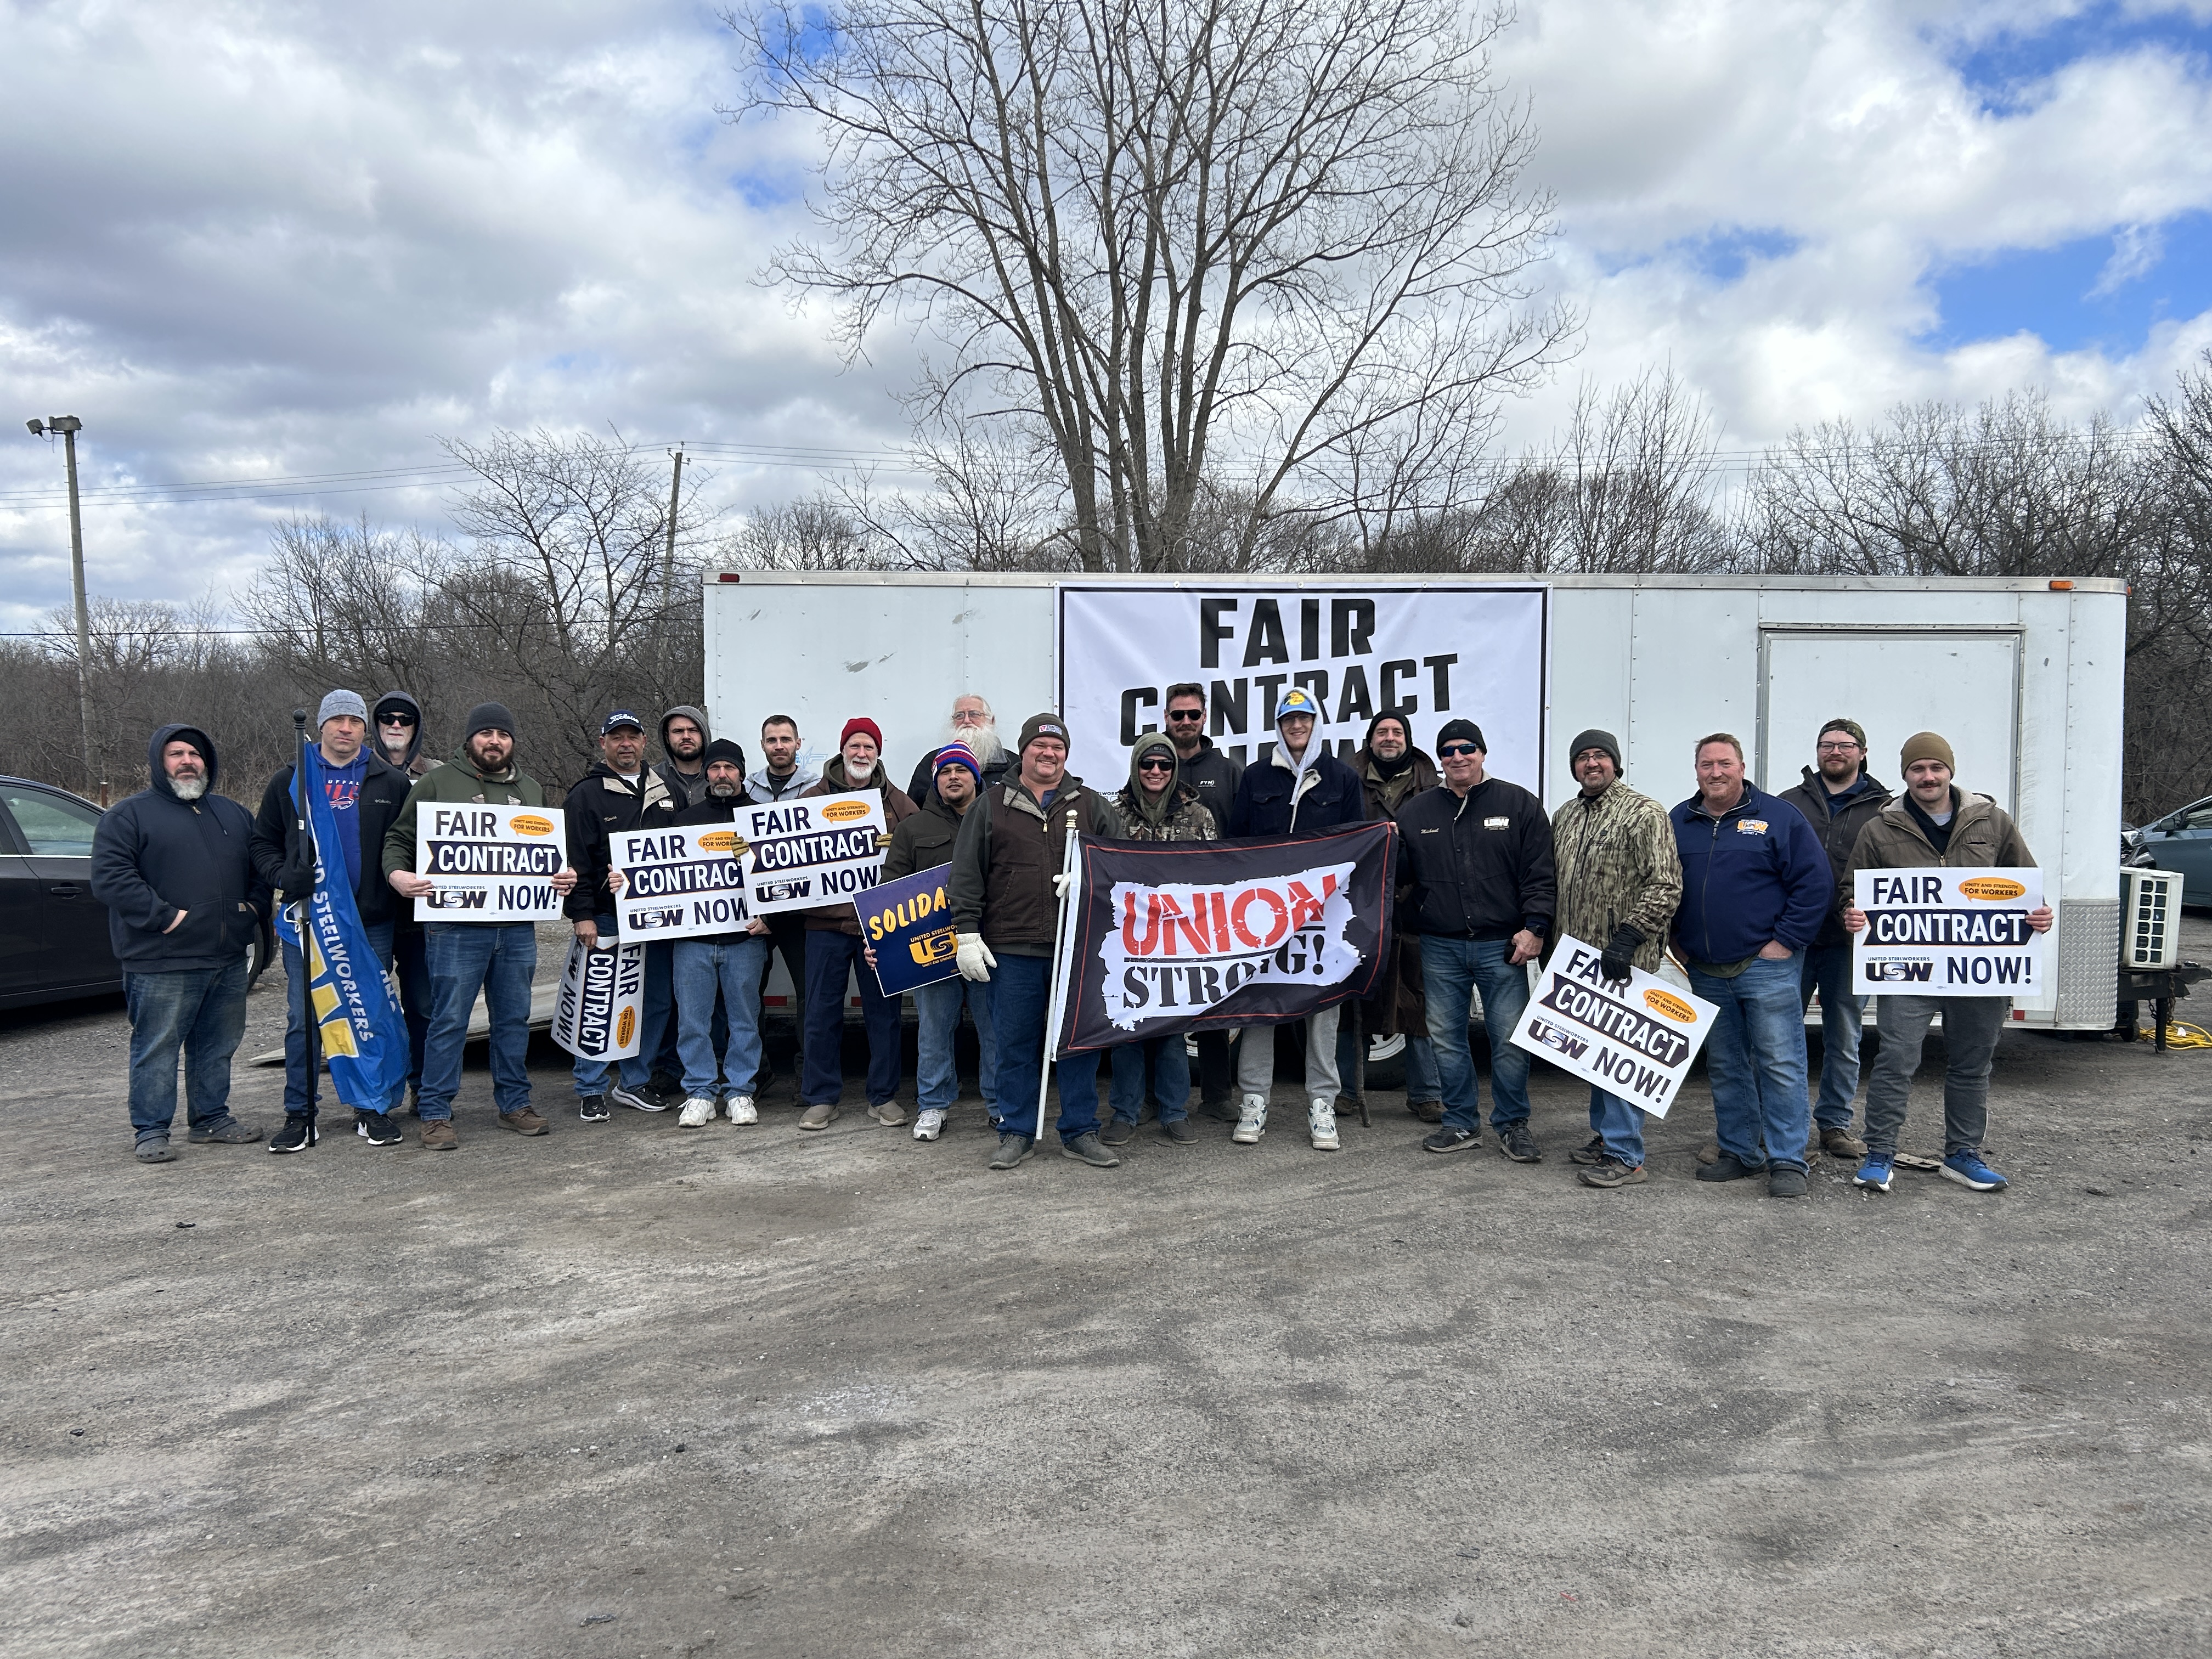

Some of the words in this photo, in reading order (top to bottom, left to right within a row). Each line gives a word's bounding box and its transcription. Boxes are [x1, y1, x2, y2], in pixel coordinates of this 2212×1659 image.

[1200, 599, 1375, 668] FAIR
[1120, 653, 1458, 747] CNTRACT
[436, 810, 497, 837] FAIR
[751, 806, 812, 837] FAIR
[1737, 821, 1769, 832] USW
[438, 844, 556, 873] CONTRACT
[627, 835, 687, 862] FAIR
[760, 828, 876, 868] CONTRACT
[636, 861, 742, 895] CONTRAC
[755, 880, 811, 902] USW
[775, 876, 808, 884] STEELWORKERS
[1873, 876, 1943, 905] FAIR
[427, 890, 488, 909] USW
[498, 885, 558, 910] NOW!
[869, 884, 951, 940] SOLIDA
[628, 909, 684, 930] USW
[1122, 873, 1336, 956] UNION
[1877, 913, 2026, 943] CONTRACT
[910, 933, 930, 942] UNITED
[313, 891, 374, 1042] STEELWORKERS
[618, 944, 641, 998] FAIR
[1565, 949, 1633, 999] FAR
[1865, 962, 1933, 981] USW
[1948, 956, 2032, 984] NOW!
[557, 983, 577, 1045] NOW!
[581, 953, 614, 1051] CONTRACT
[1646, 995, 1660, 1005] FOR
[1660, 1002, 1690, 1022] WORKERS
[1650, 991, 1663, 999] UNITY
[1672, 1003, 1692, 1015] STRENGTH
[1537, 1015, 1554, 1026] UNITED
[1554, 1024, 1589, 1043] STEELWORKERS
[1555, 984, 1686, 1063] CONTRACT
[1528, 1019, 1589, 1060] USW
[1592, 1046, 1671, 1103] NOW!
